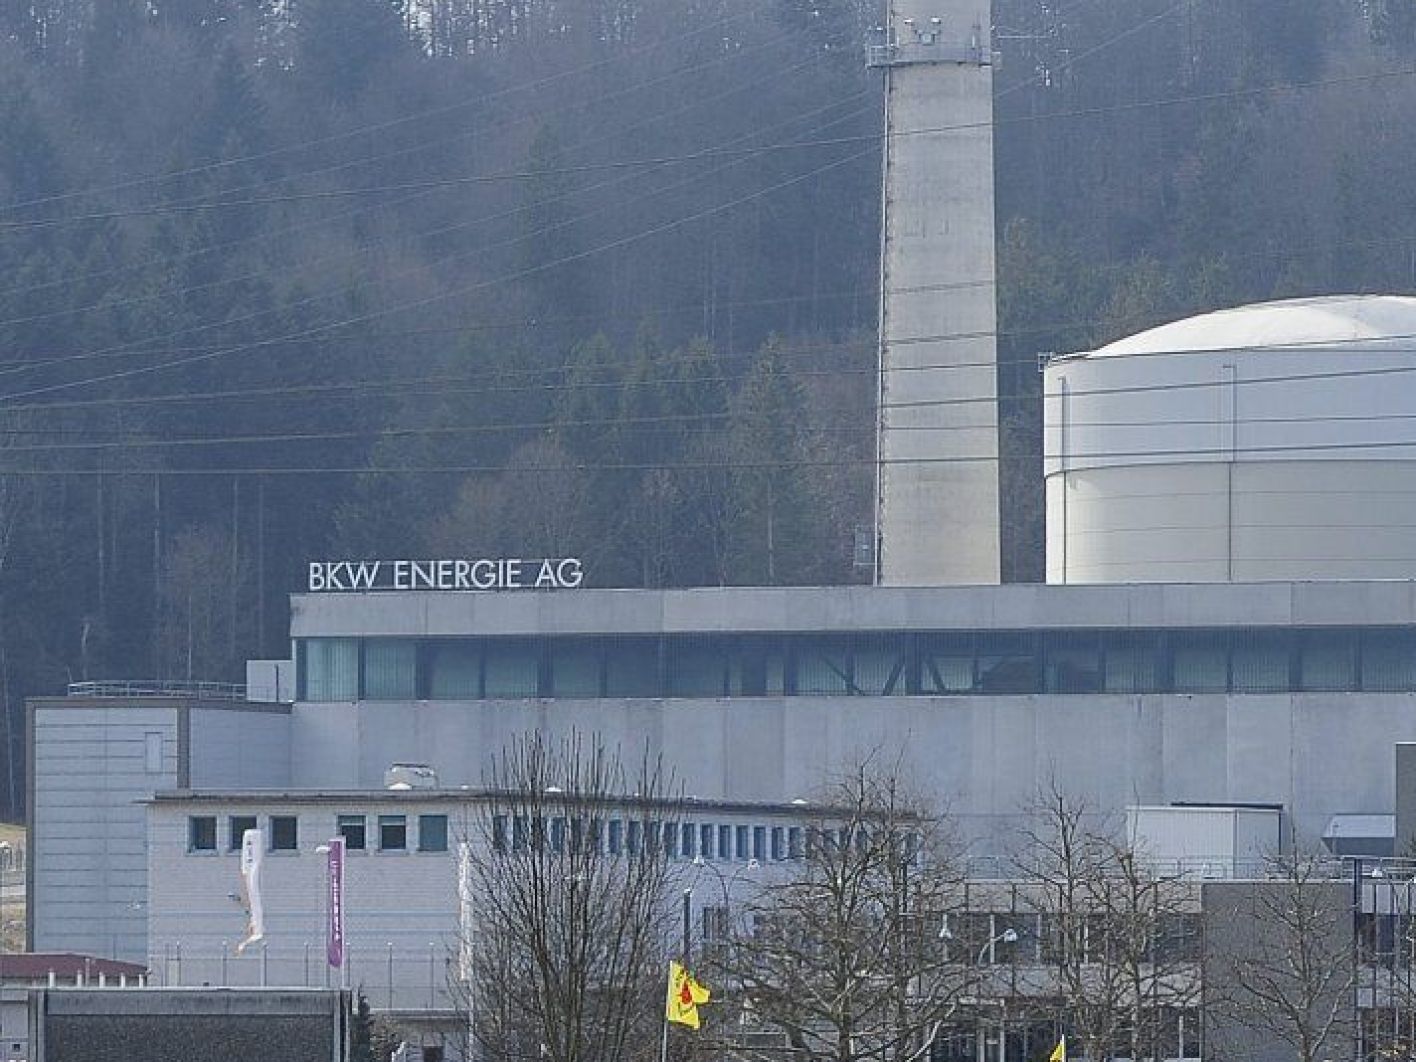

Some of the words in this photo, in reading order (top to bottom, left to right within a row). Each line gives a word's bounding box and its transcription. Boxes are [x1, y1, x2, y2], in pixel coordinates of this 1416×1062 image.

[309, 561, 380, 591] BKW
[393, 559, 522, 589] ENERGIE
[535, 558, 583, 588] AG
